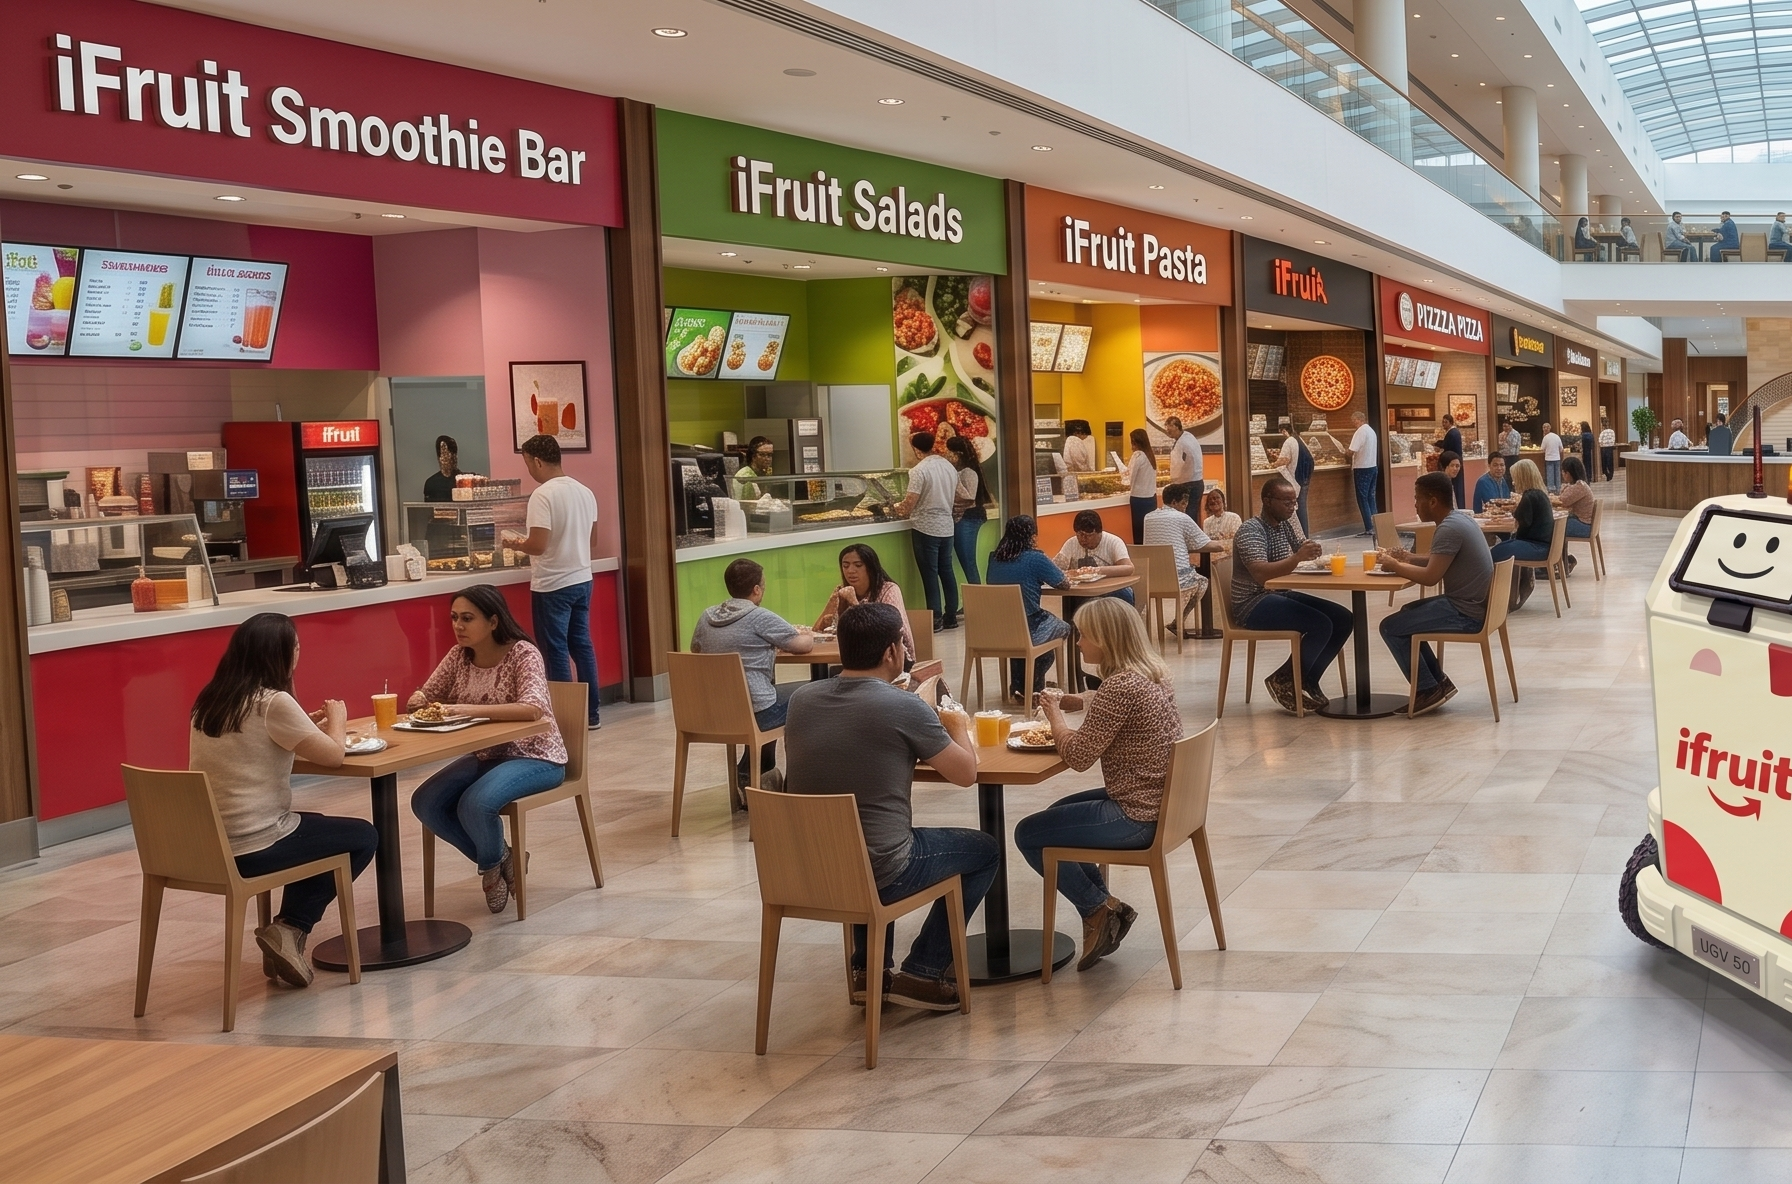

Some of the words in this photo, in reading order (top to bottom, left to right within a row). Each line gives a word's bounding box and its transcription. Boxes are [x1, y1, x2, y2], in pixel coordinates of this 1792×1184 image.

[55, 33, 251, 138] iFruit
[271, 86, 506, 174] Smoothie
[518, 128, 586, 185] Bar
[737, 155, 843, 226] iFruit
[854, 179, 963, 244] Salads
[1065, 215, 1136, 274] iFruit
[1143, 233, 1208, 285] Pasta
[1700, 937, 1729, 963] UGV
[1733, 955, 1751, 975] 50
